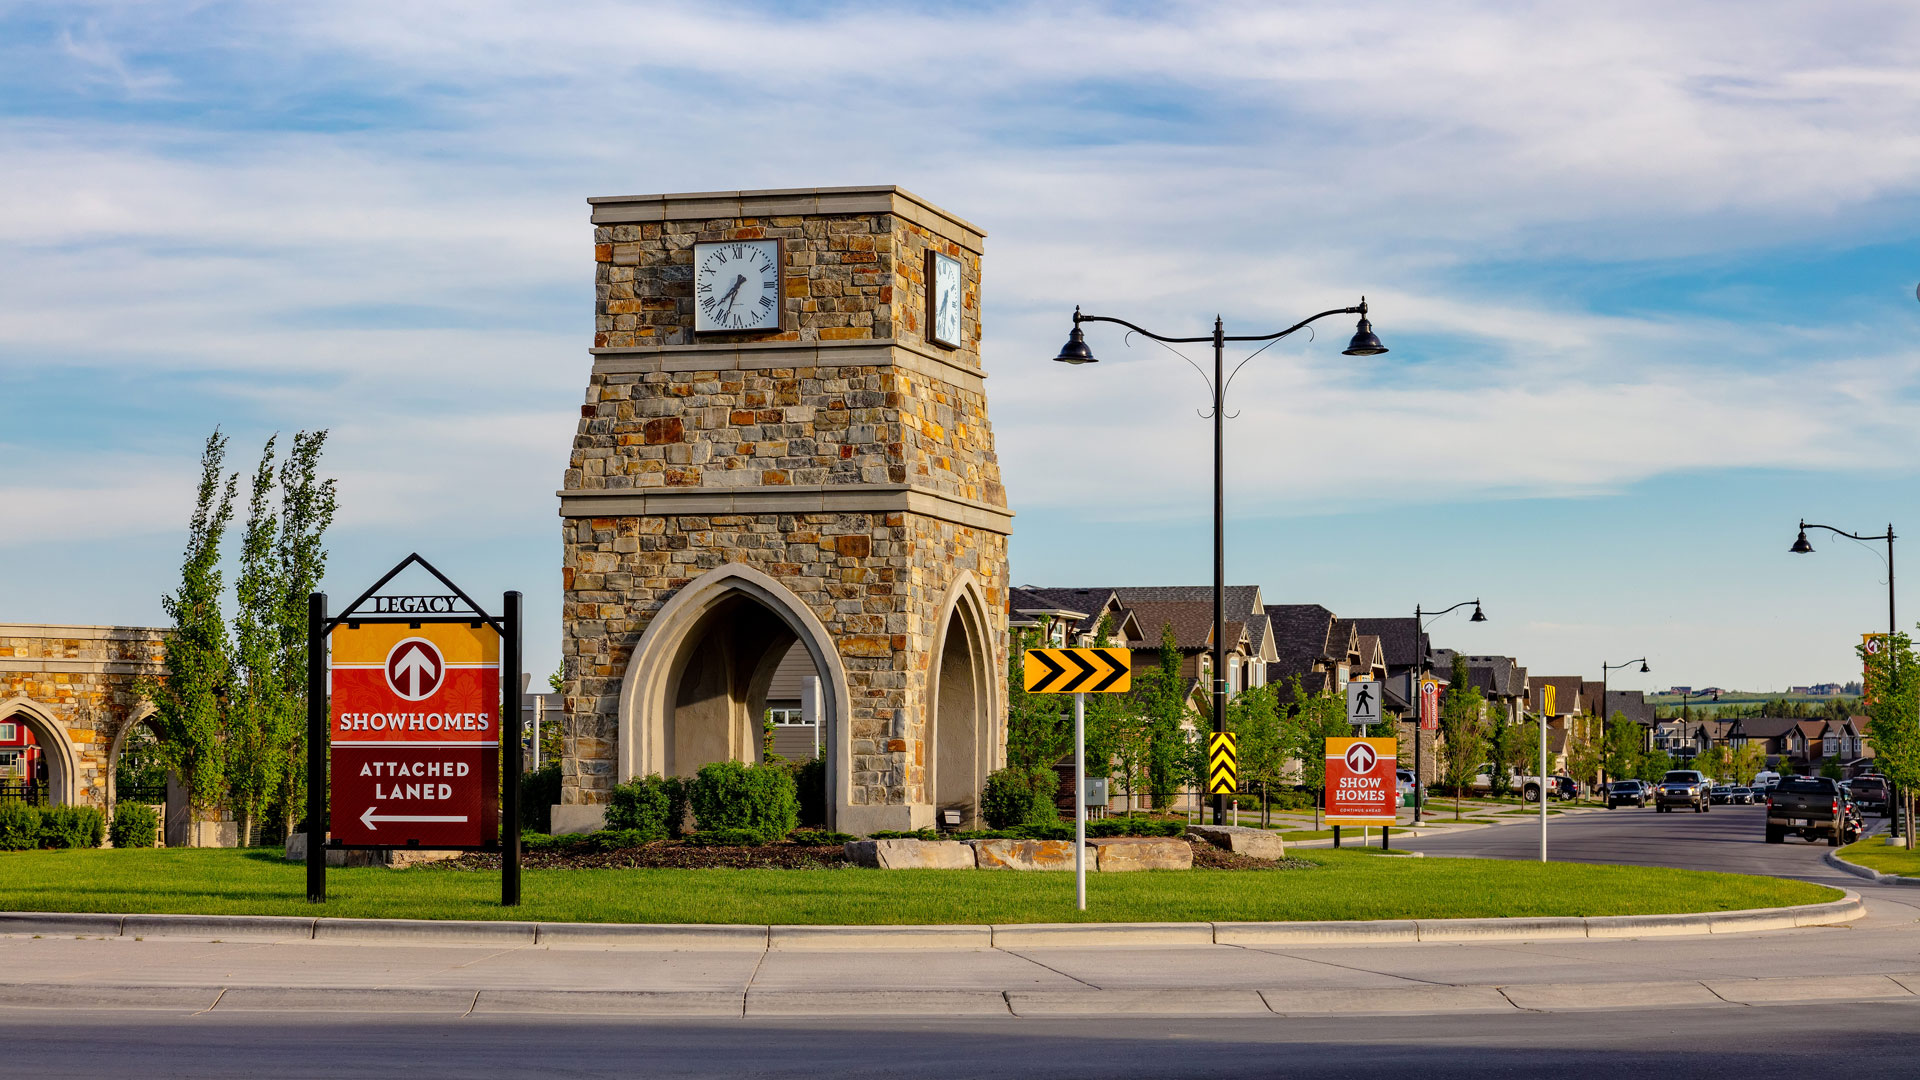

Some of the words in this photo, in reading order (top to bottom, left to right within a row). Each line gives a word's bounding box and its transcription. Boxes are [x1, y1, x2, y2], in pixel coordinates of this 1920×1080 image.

[732, 247, 742, 259] XII
[704, 266, 716, 276] X
[375, 597, 458, 613] LEGACY
[340, 712, 489, 732] SHOWHOMES
[360, 762, 470, 776] ATTACHED
[1340, 778, 1382, 788] SHOW
[375, 784, 453, 800] LANED
[1336, 790, 1385, 801] HOMES
